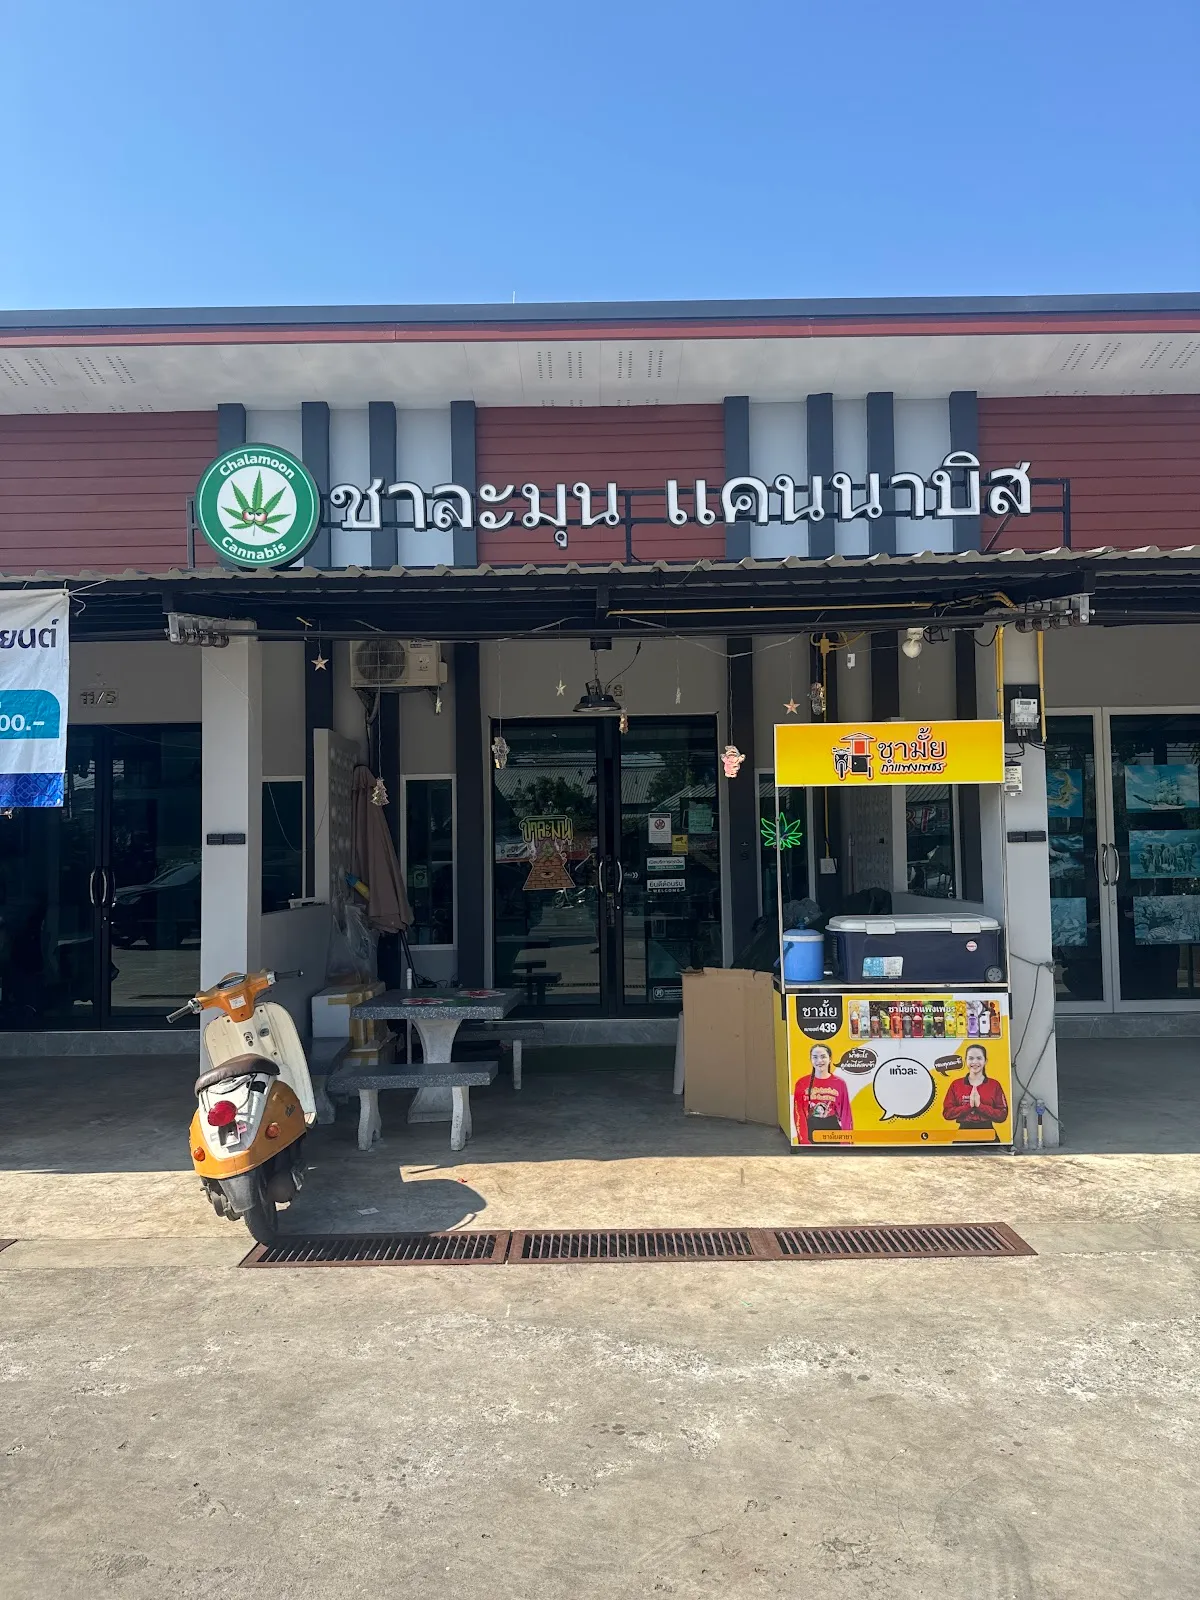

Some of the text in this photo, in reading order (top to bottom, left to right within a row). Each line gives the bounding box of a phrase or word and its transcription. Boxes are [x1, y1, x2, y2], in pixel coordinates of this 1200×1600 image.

[219, 453, 296, 480] Chalamoon
[330, 450, 1034, 550] ชาละมุน แคนนาบิส
[221, 536, 288, 561] Cannabis
[878, 727, 945, 759] ชามั้ย
[881, 759, 944, 772] กำแพงเพชร
[802, 999, 838, 1017] ชามั้ย
[819, 1022, 837, 1033] 439
[889, 1064, 918, 1076] แก้วละ
